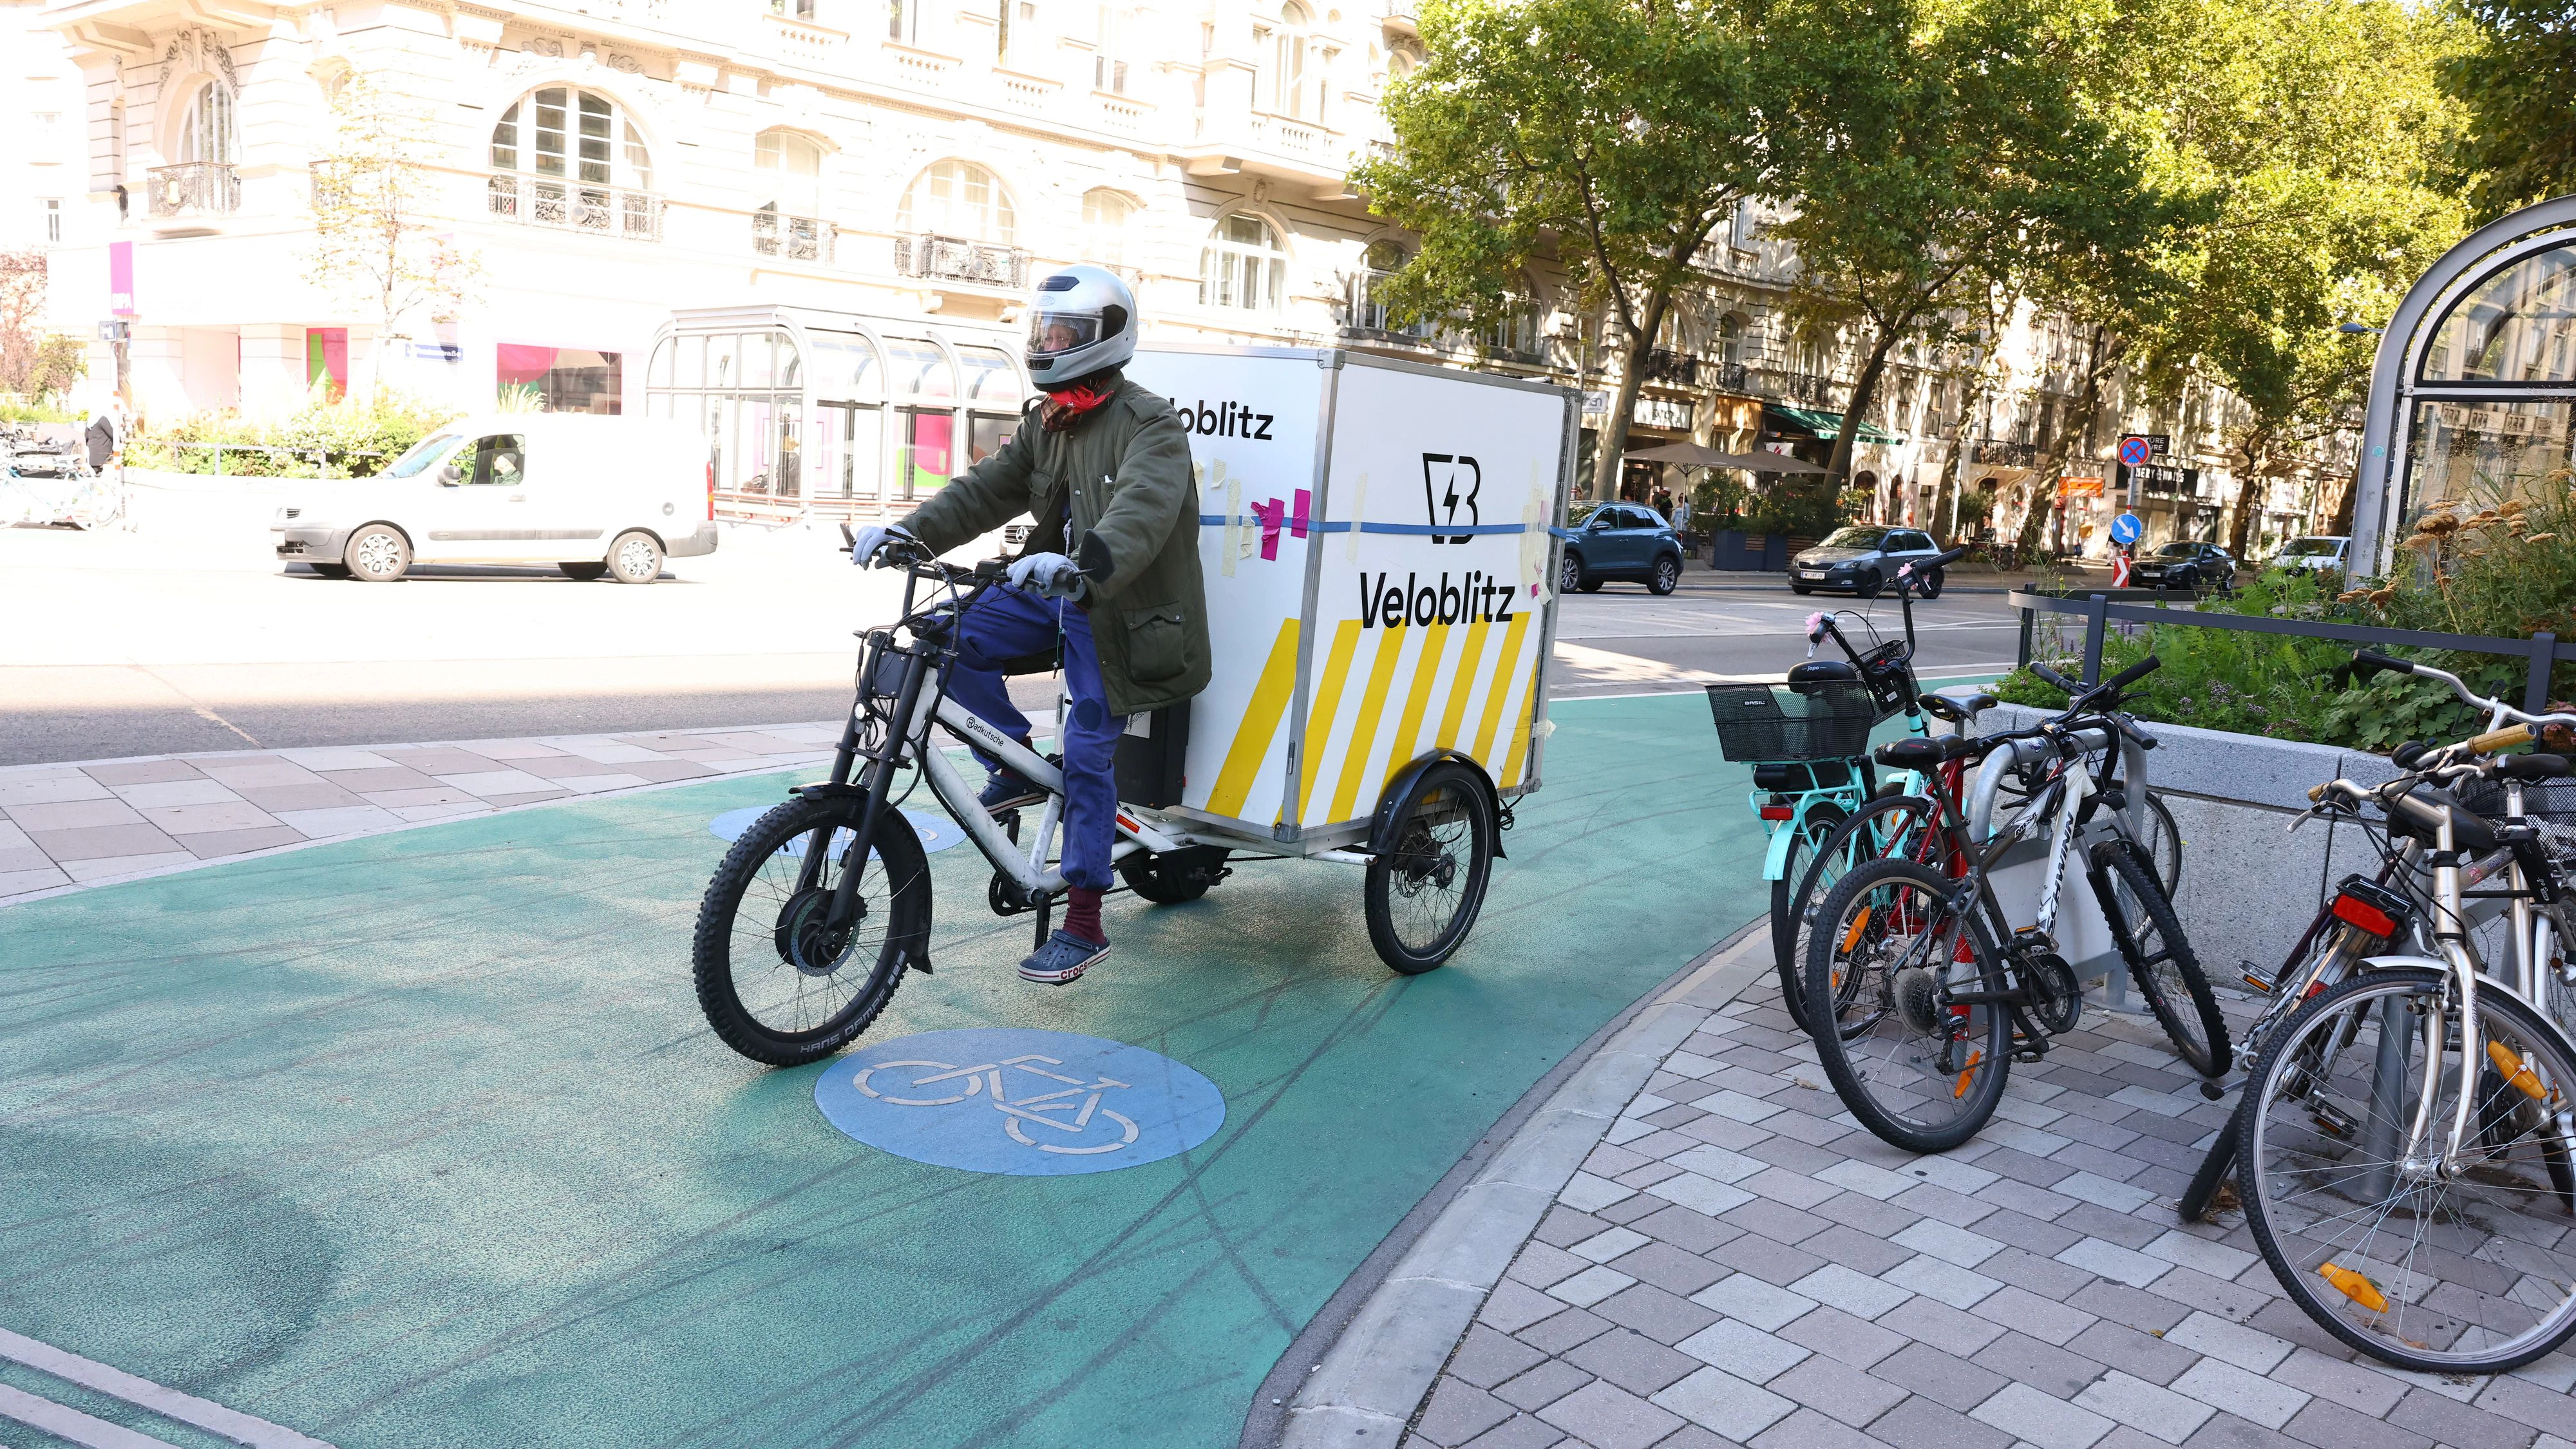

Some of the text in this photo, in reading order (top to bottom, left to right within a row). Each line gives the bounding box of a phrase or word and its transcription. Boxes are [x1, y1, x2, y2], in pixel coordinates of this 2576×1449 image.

[1170, 397, 1274, 440] oblitz
[1359, 570, 1515, 629] Veloblitz
[2047, 810, 2074, 936] SCHWINN
[1060, 961, 1088, 980] crocs
[800, 988, 886, 1054] HANS DAMPF
